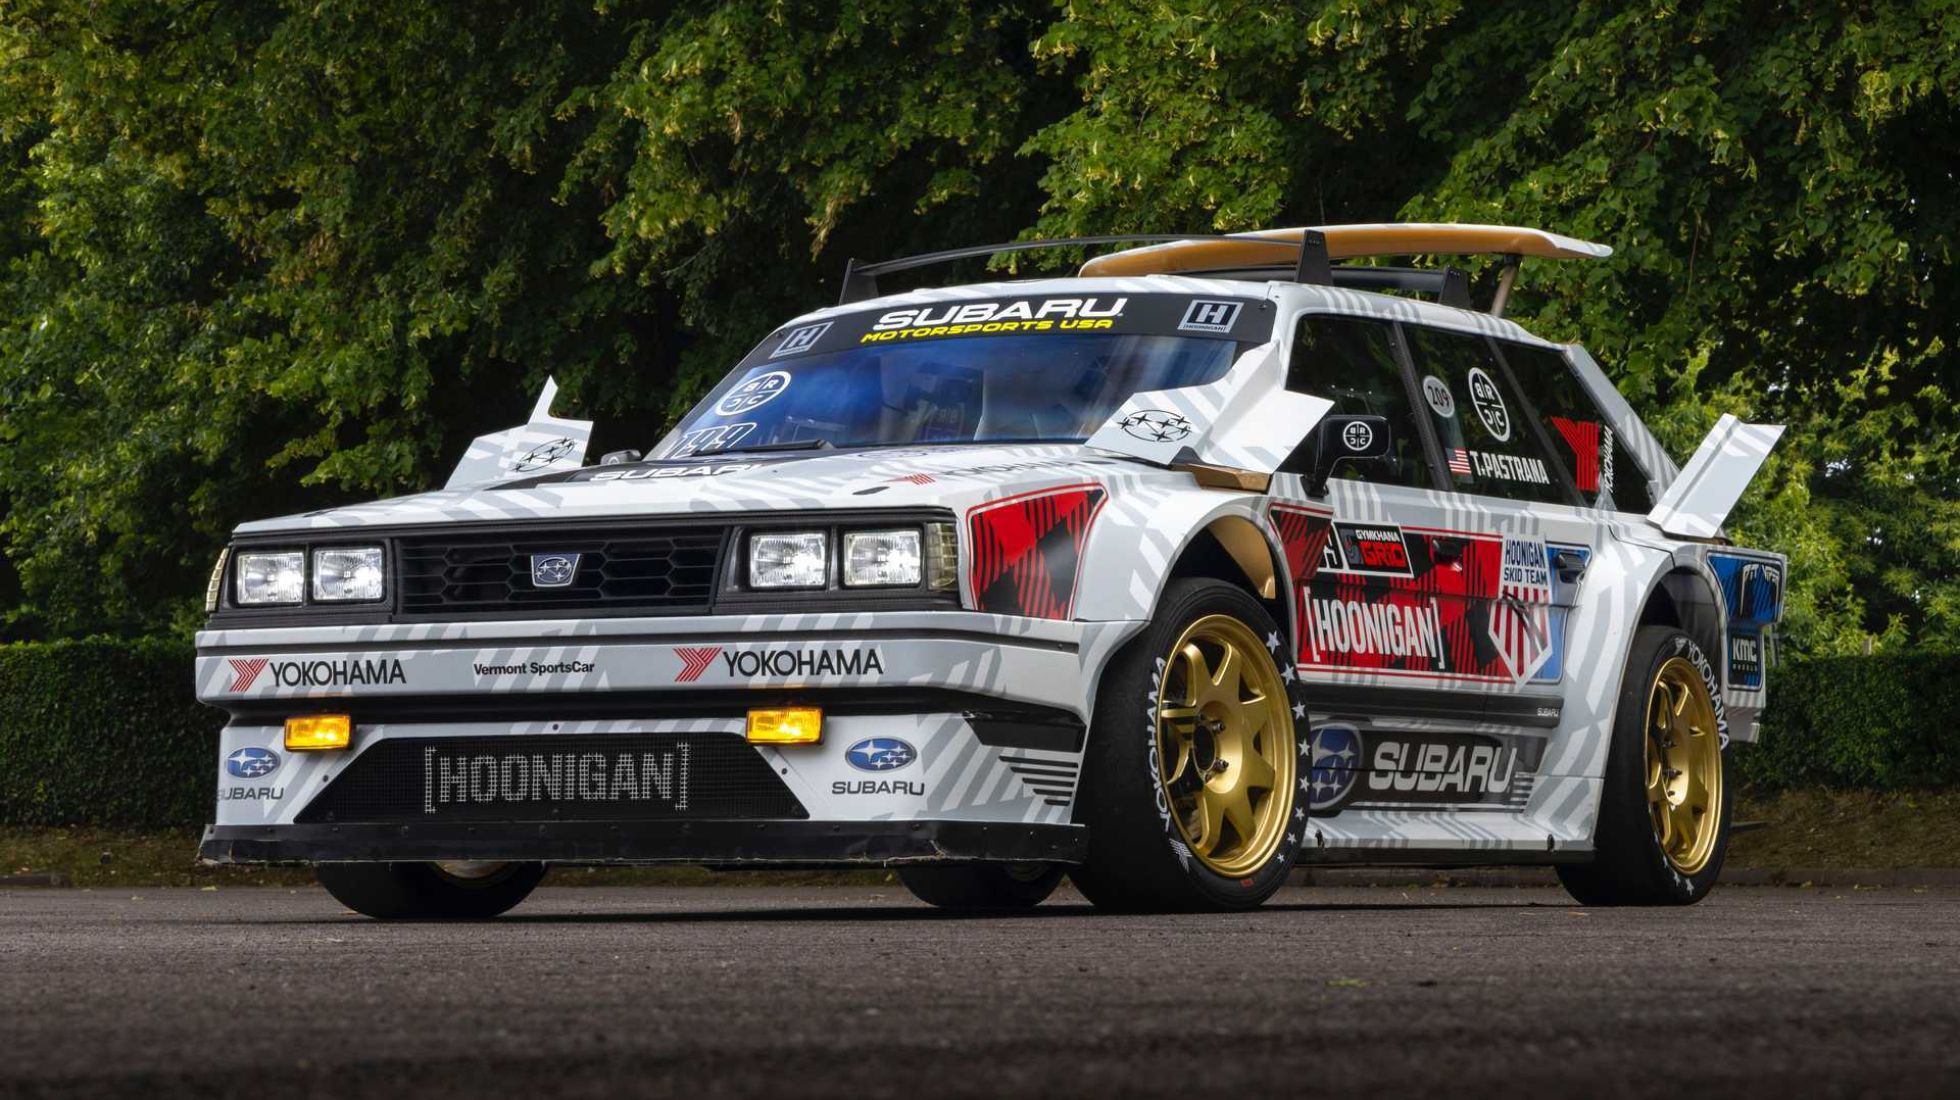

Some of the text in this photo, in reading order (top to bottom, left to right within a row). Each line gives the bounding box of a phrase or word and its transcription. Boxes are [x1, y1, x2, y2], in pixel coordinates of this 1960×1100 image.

[873, 298, 1128, 331] SUBARU
[1195, 304, 1228, 323] H
[860, 318, 1114, 343] MOTORSPORTS USA
[1426, 384, 1451, 407] 209
[1469, 450, 1550, 485] T.PASTRANA
[1355, 529, 1401, 542] GYMKHANA
[1504, 539, 1547, 570] HOONIGAN
[1503, 568, 1548, 585] SKID TEAM
[269, 659, 406, 687] YOKOHAMA
[474, 662, 594, 675] Vermont SportsCar
[722, 648, 884, 677] YOKOHAMA
[1687, 639, 1730, 751] YOKOHAMA
[1368, 741, 1517, 793] SUBARU
[831, 780, 925, 796] SUBARU
